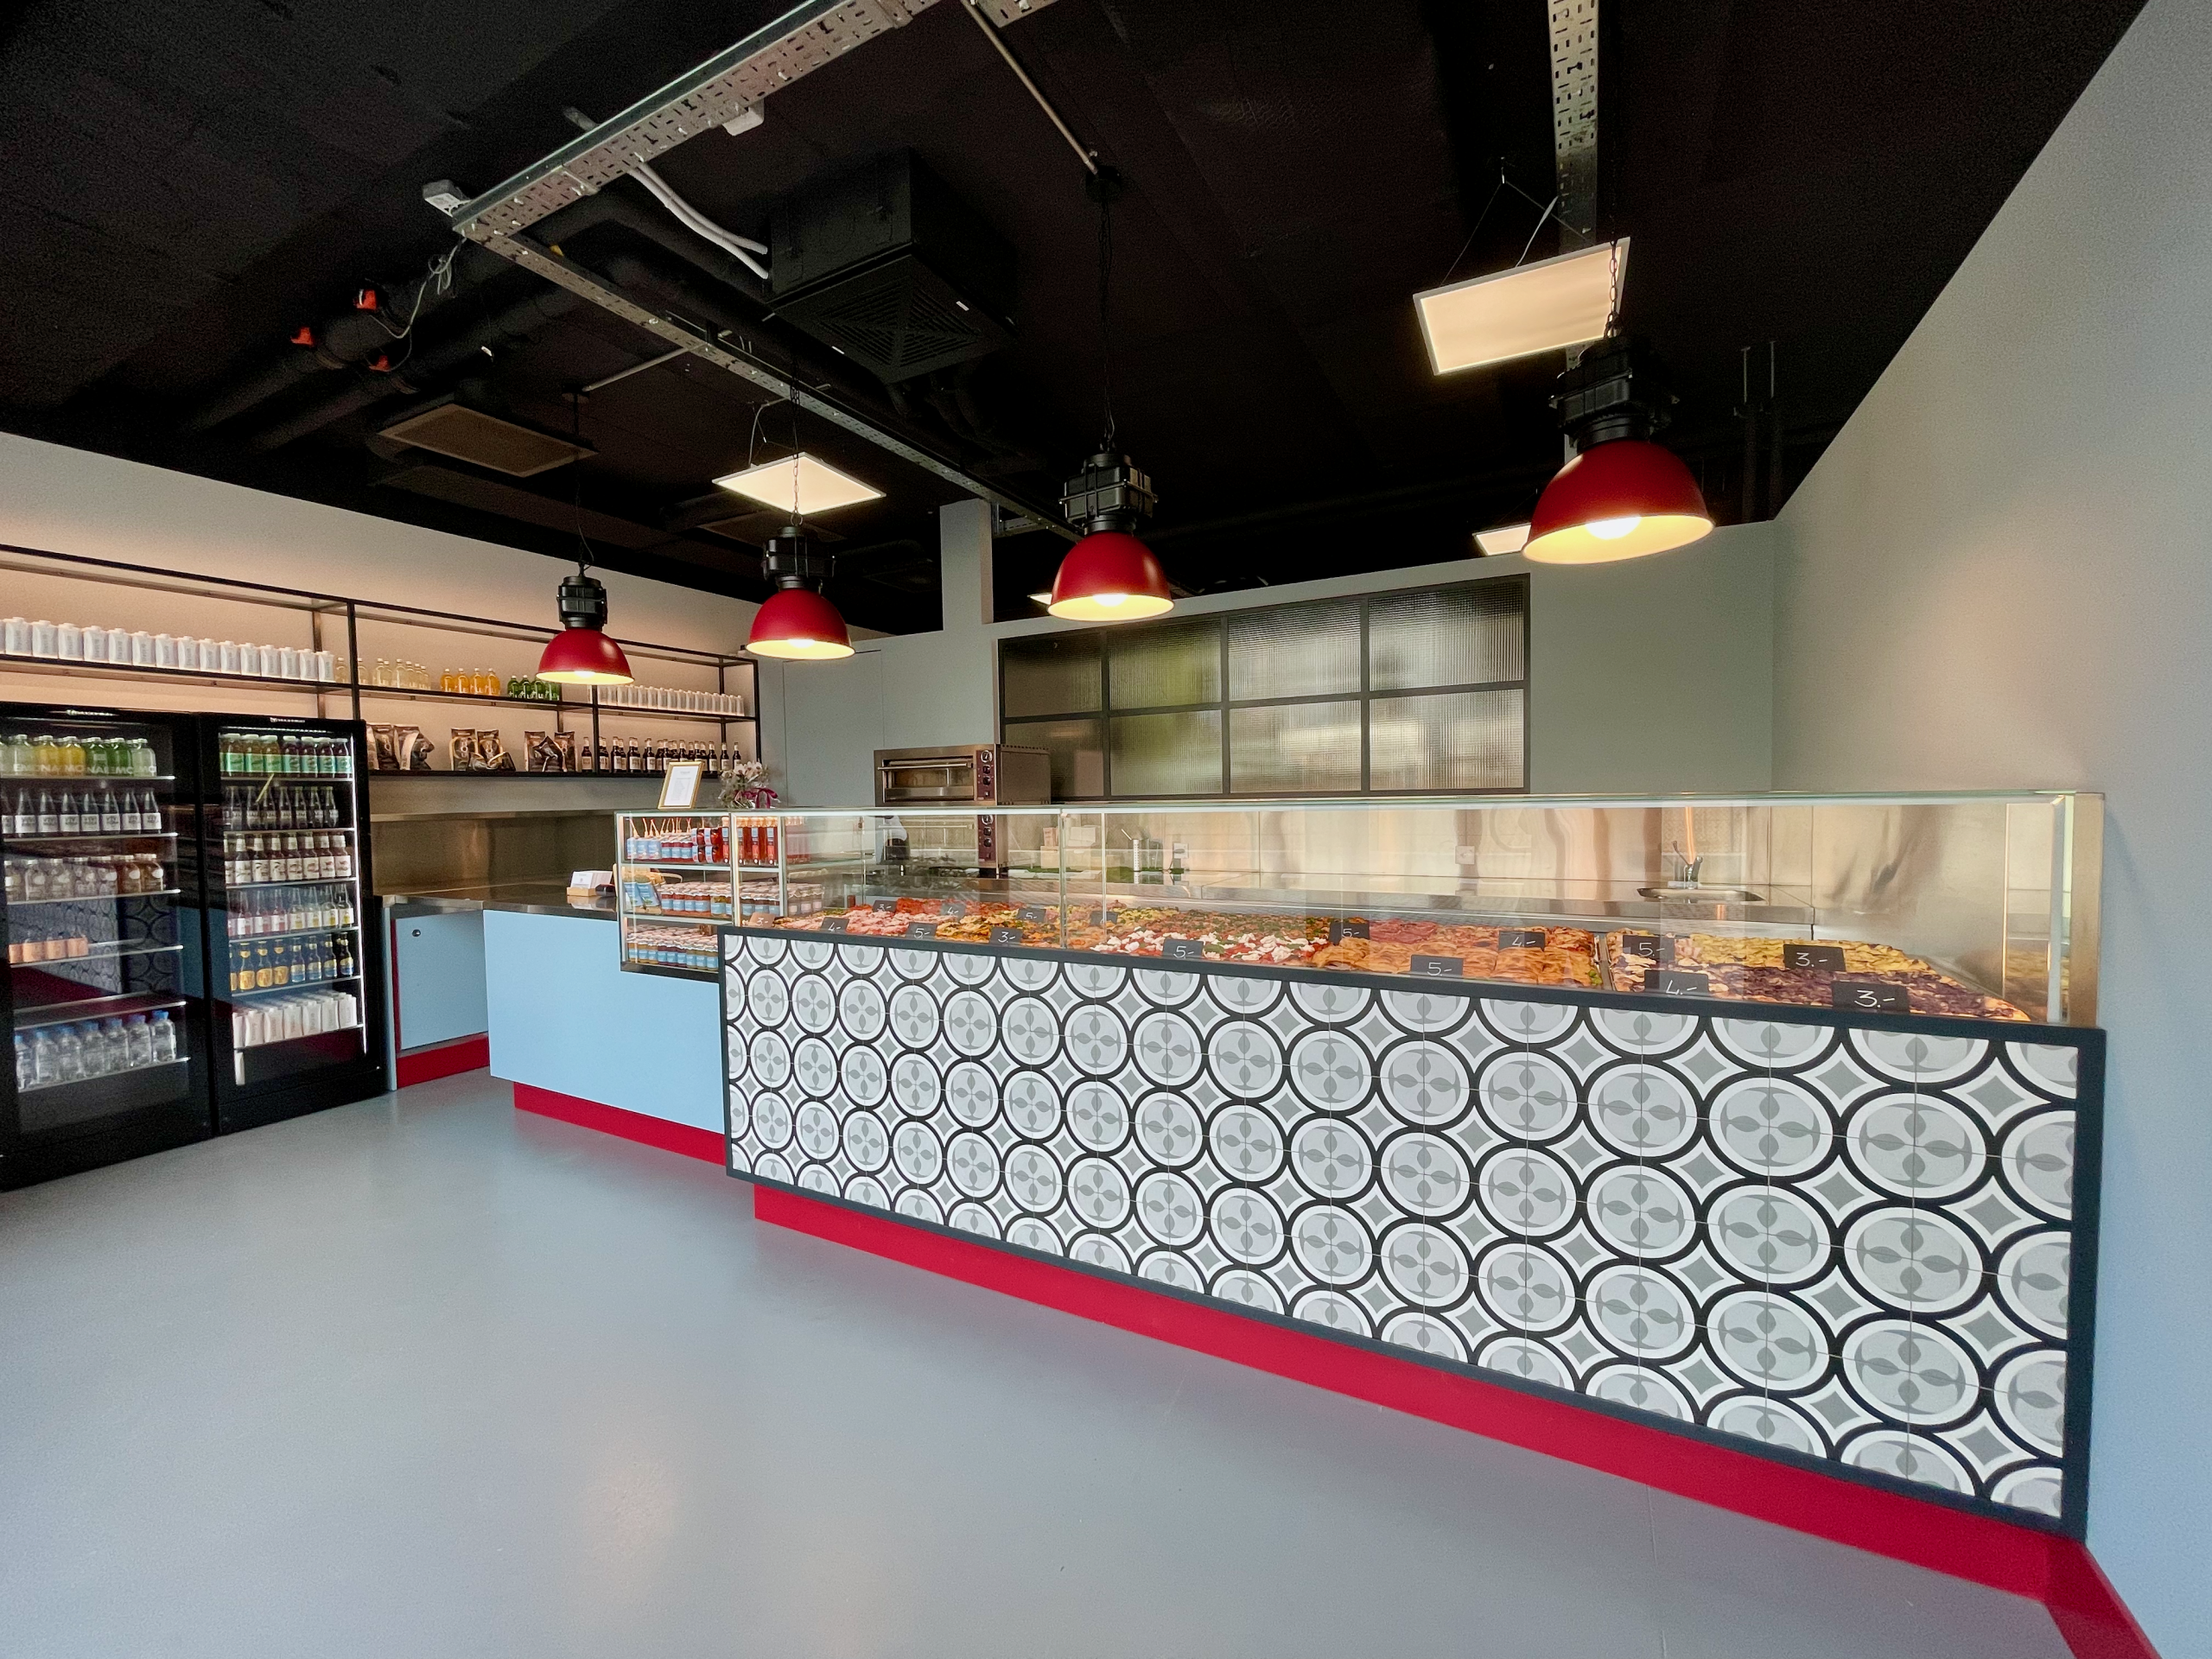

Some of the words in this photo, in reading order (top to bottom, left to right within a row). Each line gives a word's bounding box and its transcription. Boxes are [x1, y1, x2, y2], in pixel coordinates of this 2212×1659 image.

[1795, 951, 1828, 968] 3.-
[1664, 979, 1698, 995] 4.-
[1853, 988, 1896, 1008] 3.-
